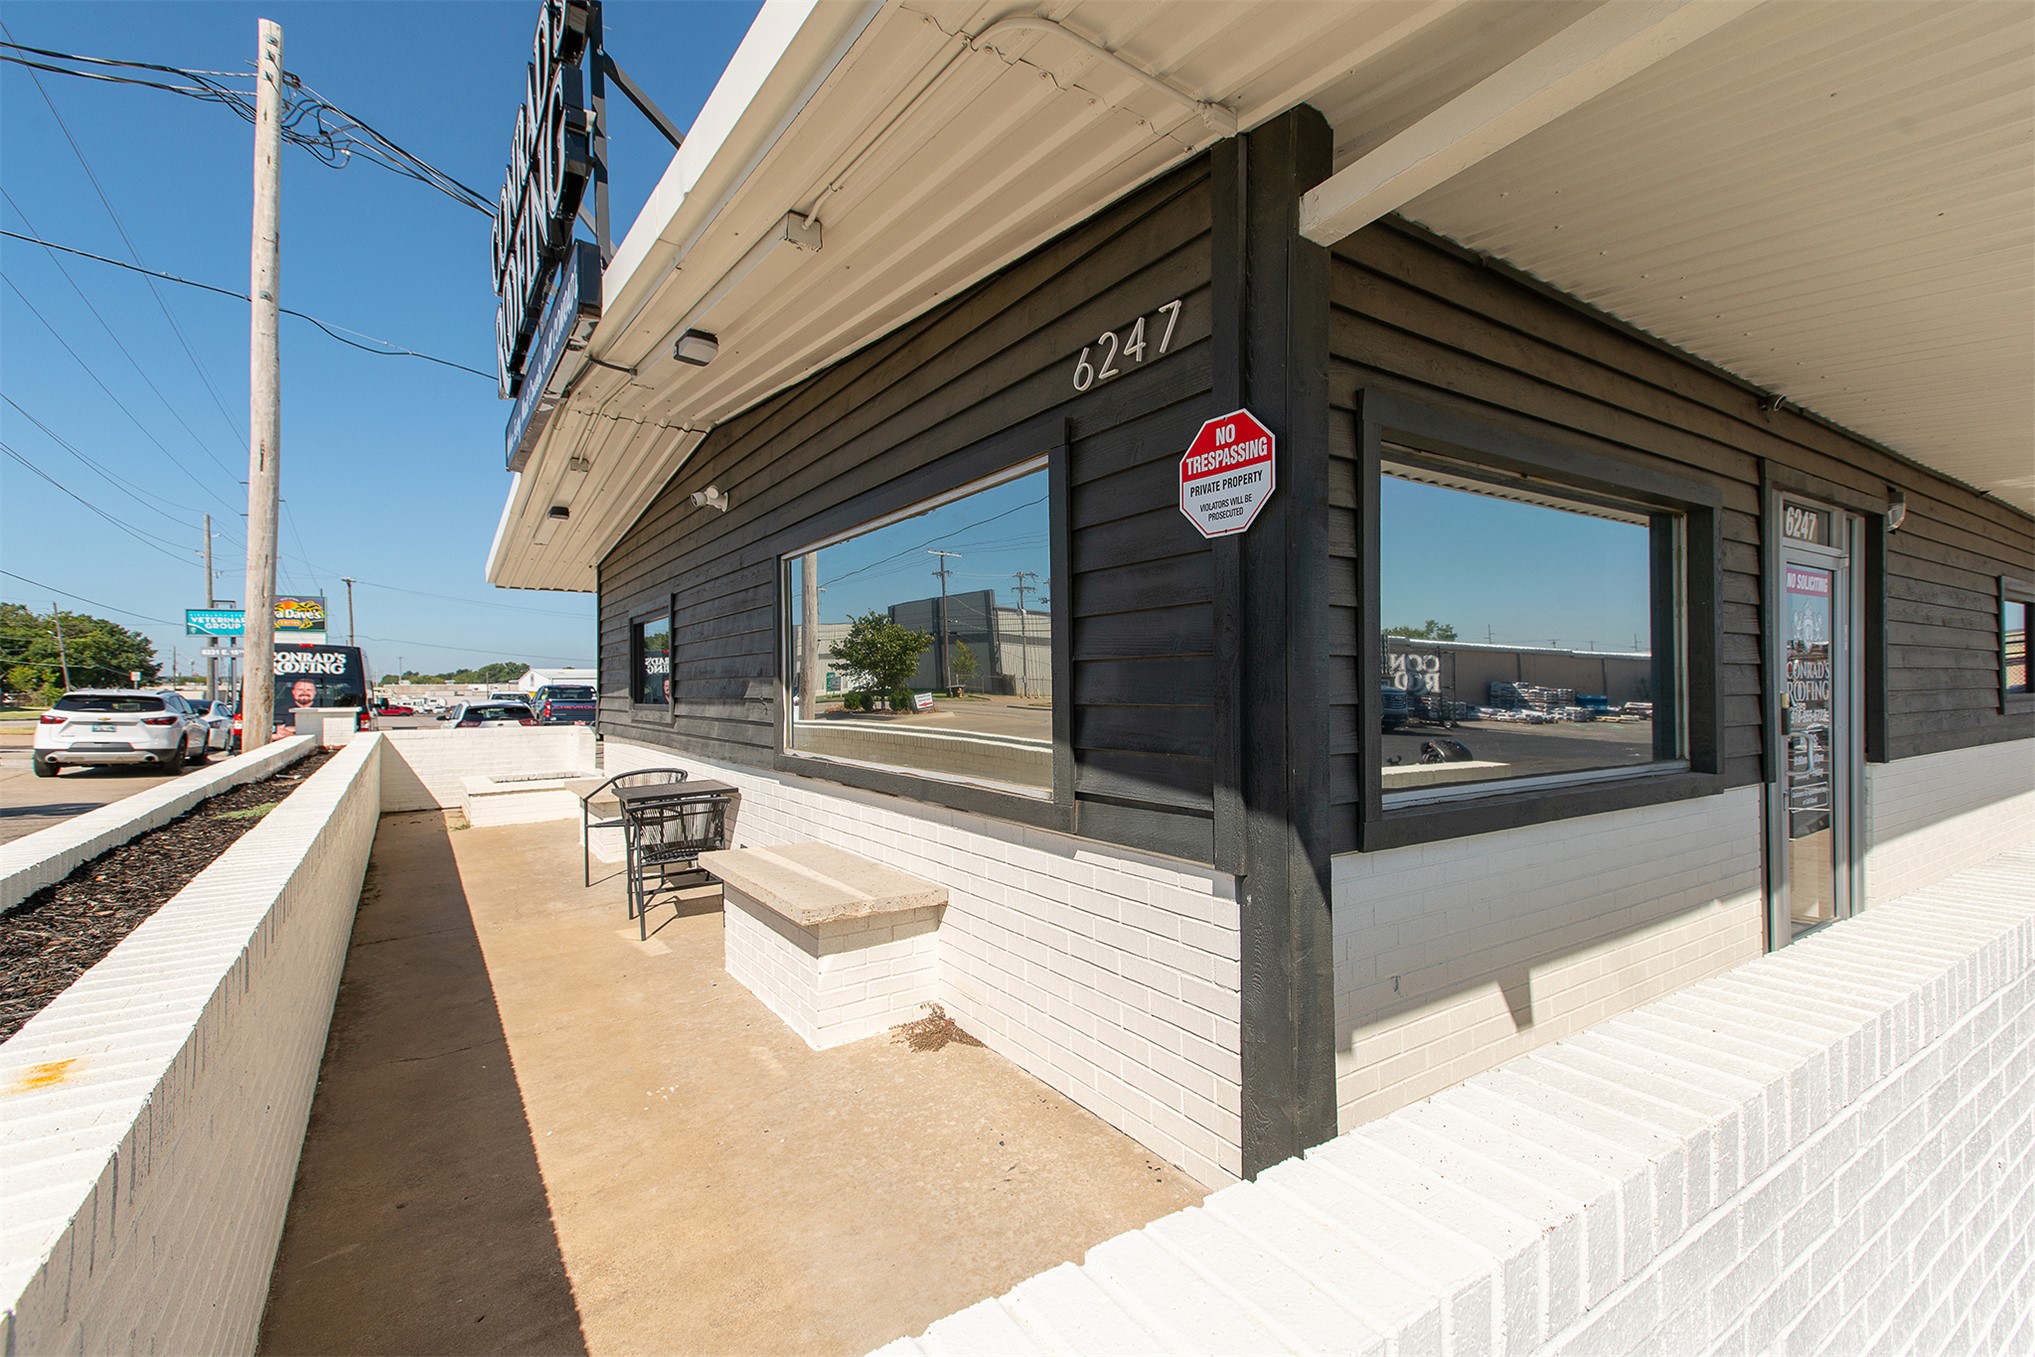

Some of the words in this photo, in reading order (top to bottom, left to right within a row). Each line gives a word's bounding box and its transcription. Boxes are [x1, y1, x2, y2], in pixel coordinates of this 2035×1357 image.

[1073, 299, 1182, 391] 6247
[1215, 423, 1236, 446] NO
[1186, 436, 1268, 476] TRESPASSING
[1190, 480, 1221, 498] PRIVATE
[1222, 469, 1263, 491] PROPERTY
[1200, 498, 1230, 513] VIOLATORS
[1229, 496, 1244, 506] WILL
[1244, 493, 1253, 503] BE
[1208, 506, 1244, 522] PROSECUTED
[1786, 506, 1817, 541] 6247
[1787, 572, 1797, 589] NO
[1797, 574, 1829, 593] SOLICITING
[285, 608, 322, 619] Dave's
[1786, 660, 1830, 680] CONRAD'S
[1787, 680, 1830, 707] ROOFING
